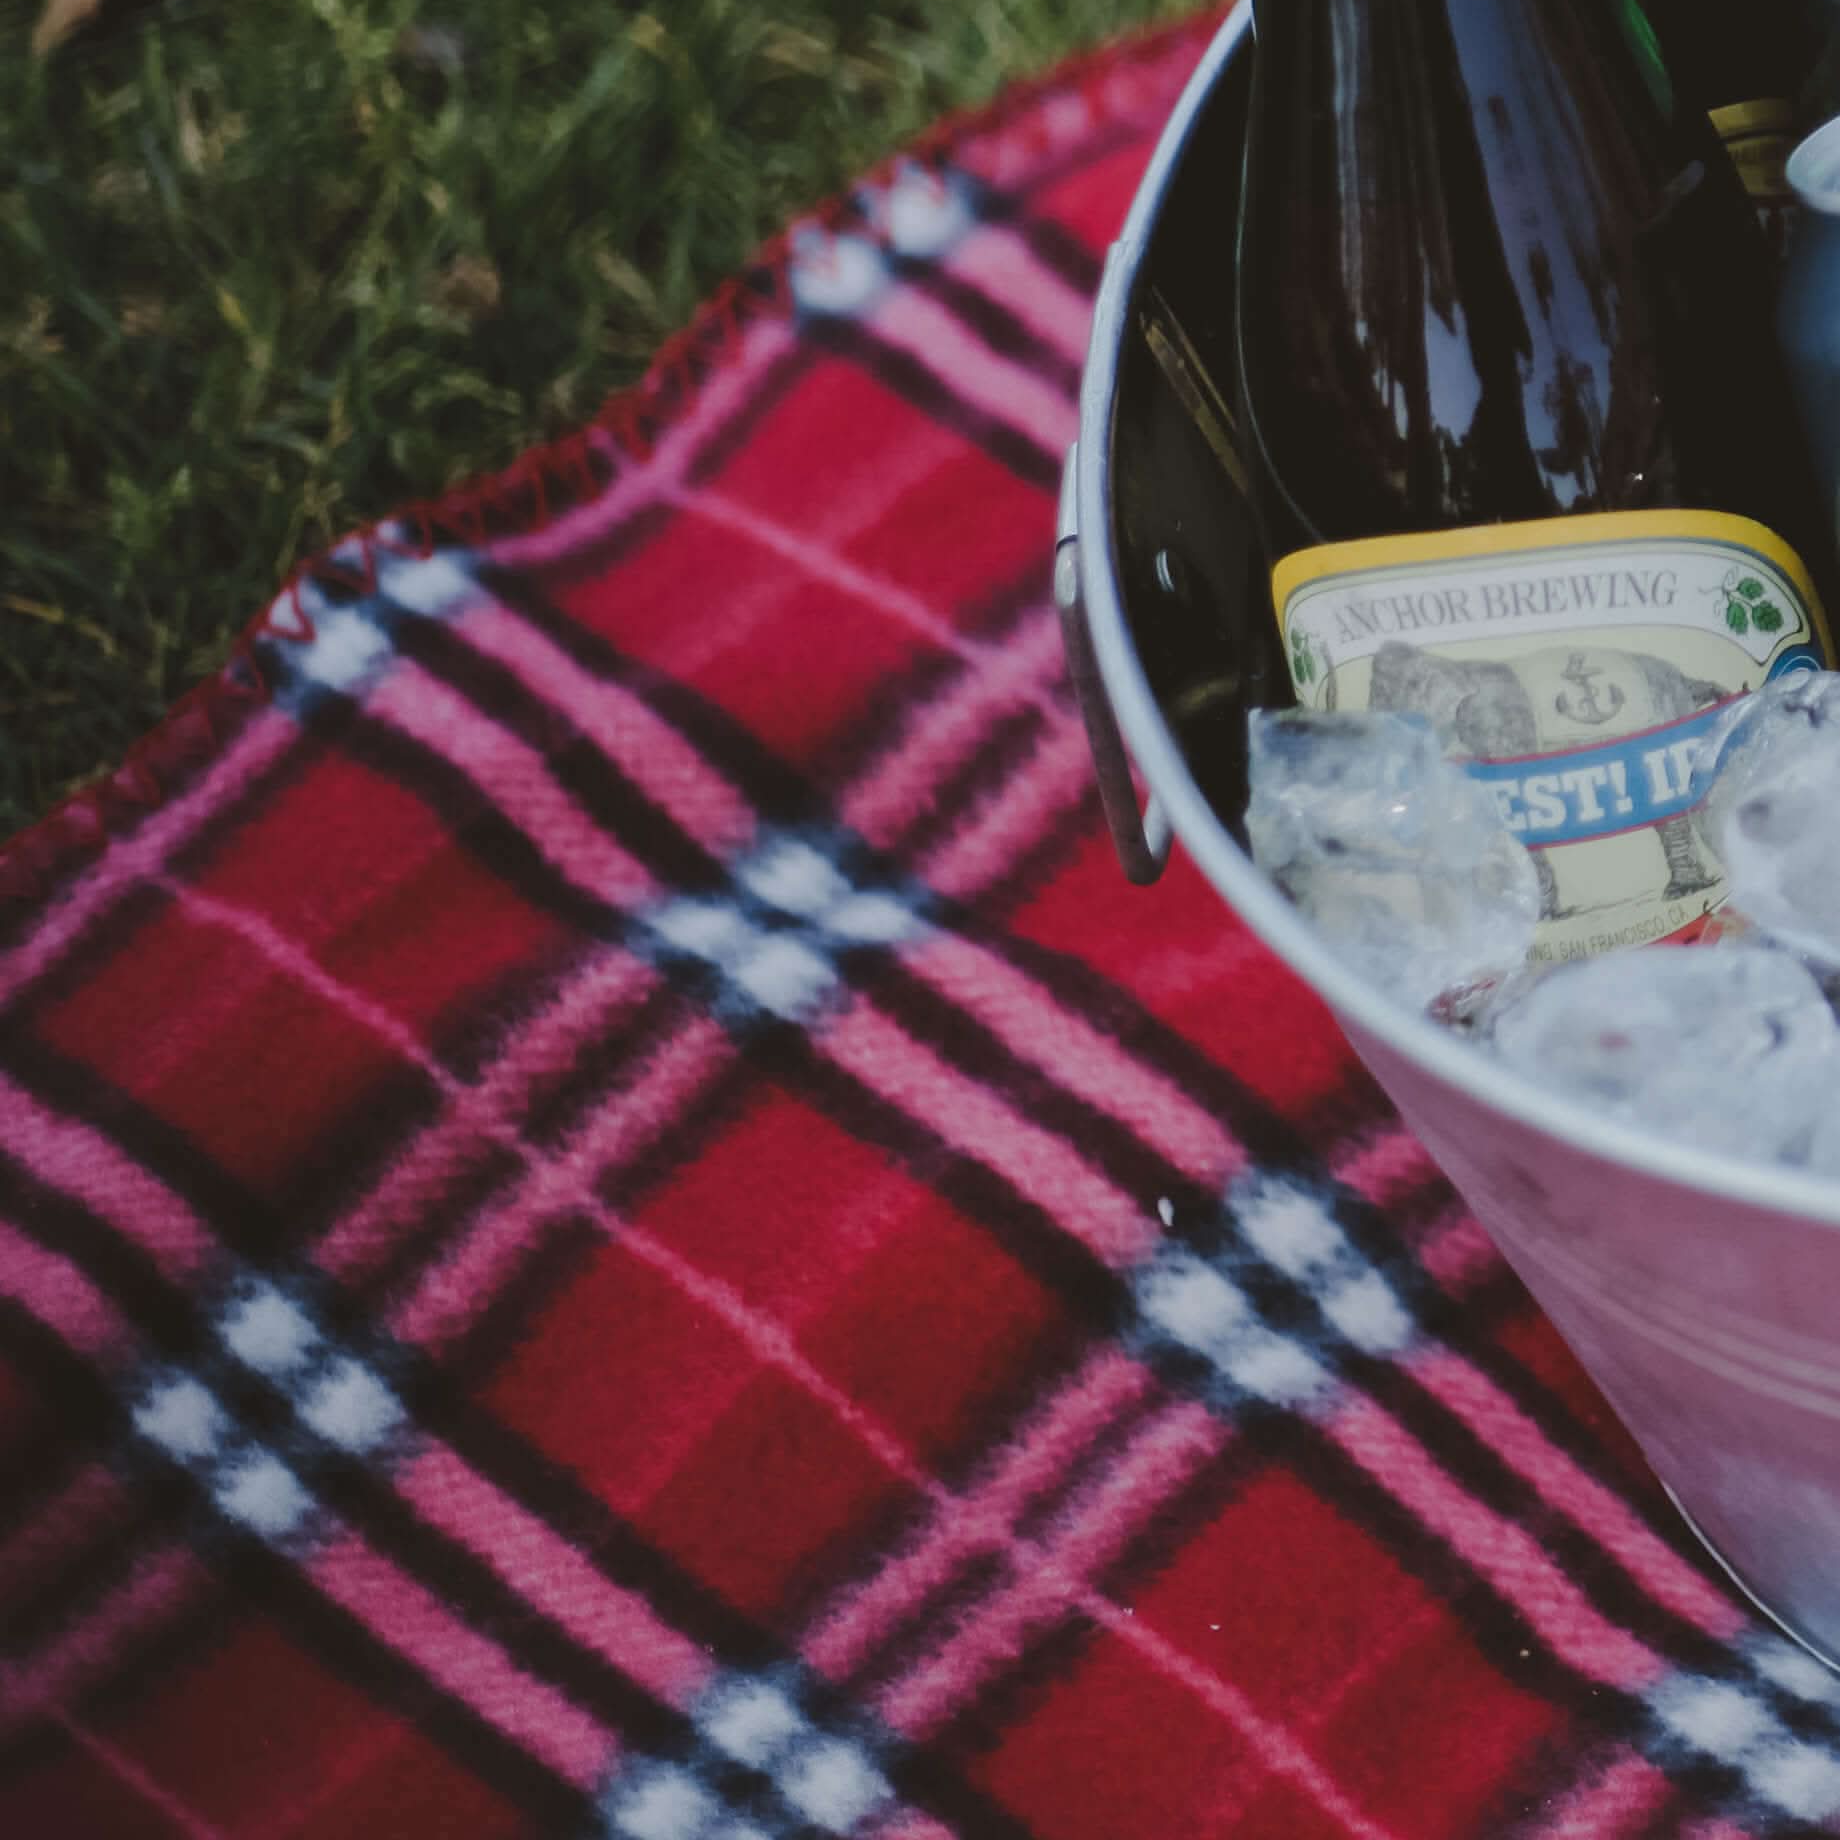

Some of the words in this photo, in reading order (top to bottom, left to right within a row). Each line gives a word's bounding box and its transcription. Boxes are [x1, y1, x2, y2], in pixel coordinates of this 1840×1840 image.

[1333, 586, 1474, 645] ANCHOR
[1481, 569, 1680, 622] BREWING
[1560, 940, 1587, 960] SAN
